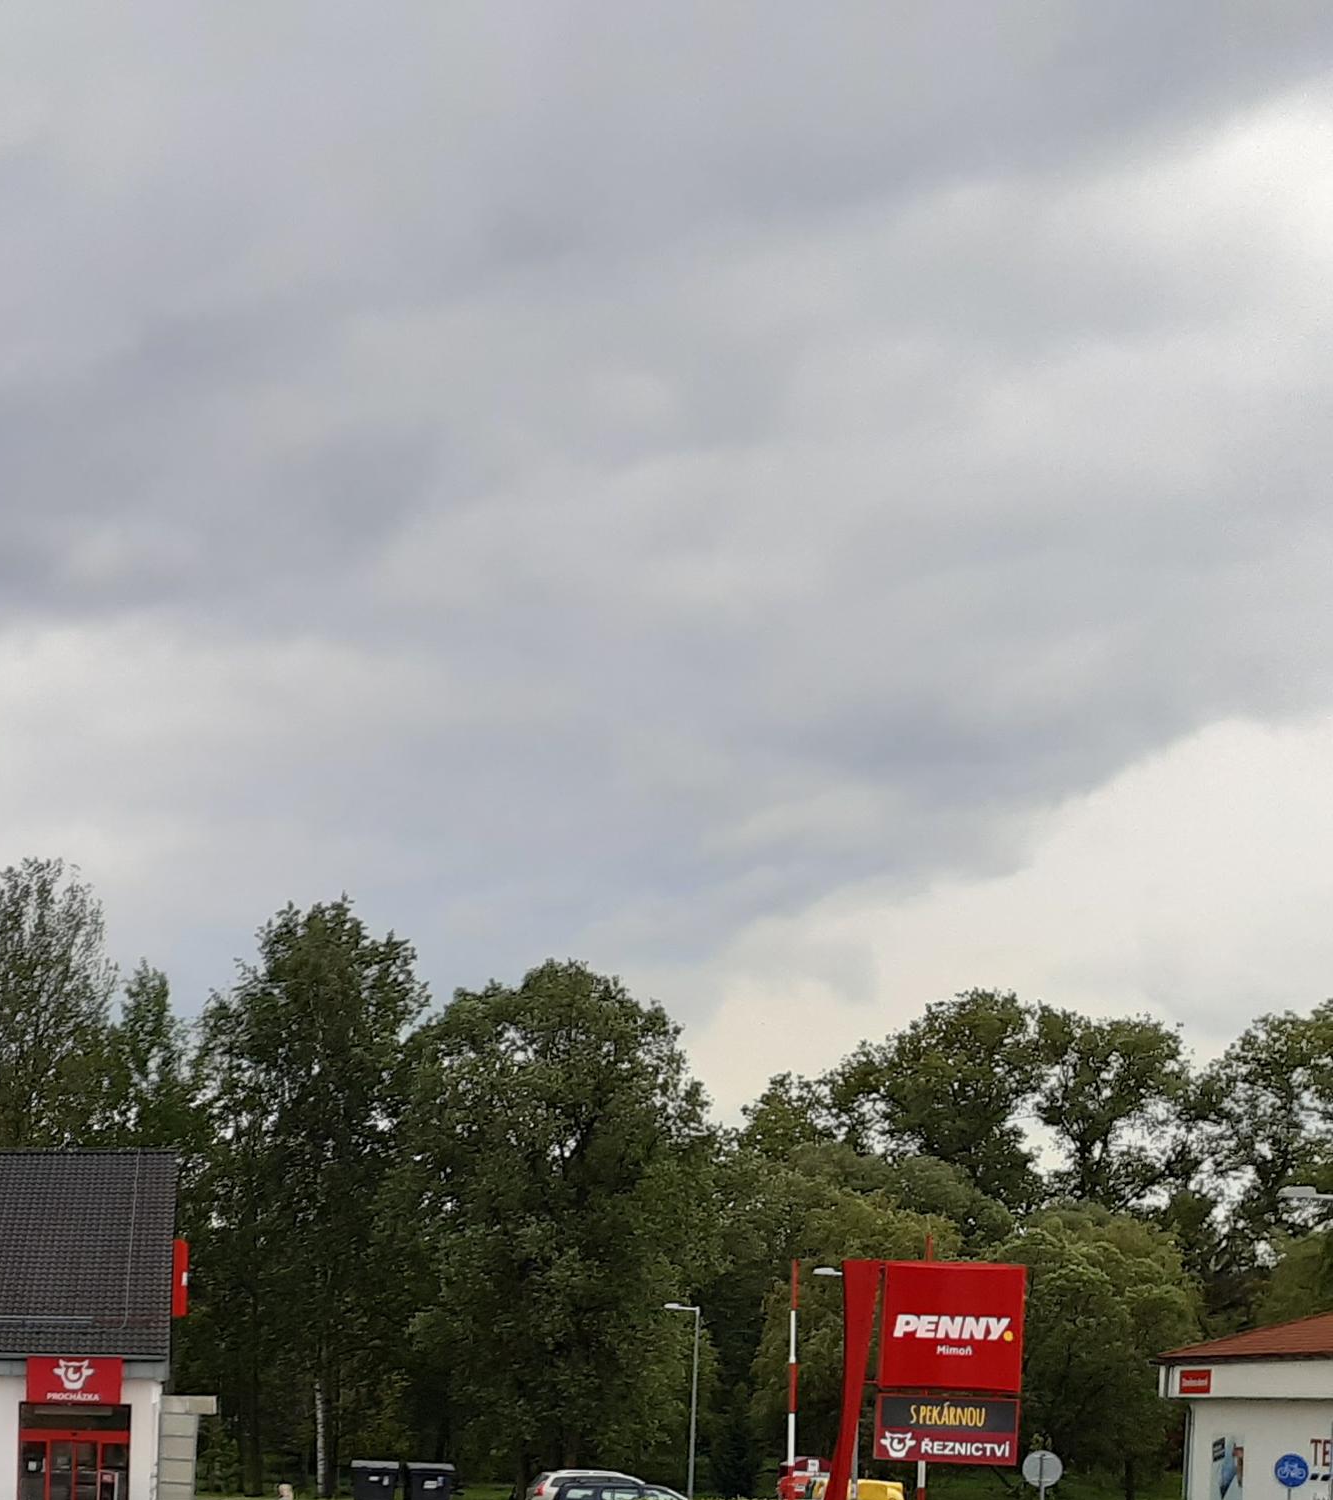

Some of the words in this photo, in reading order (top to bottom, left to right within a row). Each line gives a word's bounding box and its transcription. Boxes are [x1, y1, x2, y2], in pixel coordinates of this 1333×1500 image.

[936, 1345, 973, 1356] Mimoň
[910, 1404, 917, 1424] S
[919, 1401, 986, 1427] PEKÁRNOU
[920, 1438, 1010, 1457] ŘEZNICTVÍ
